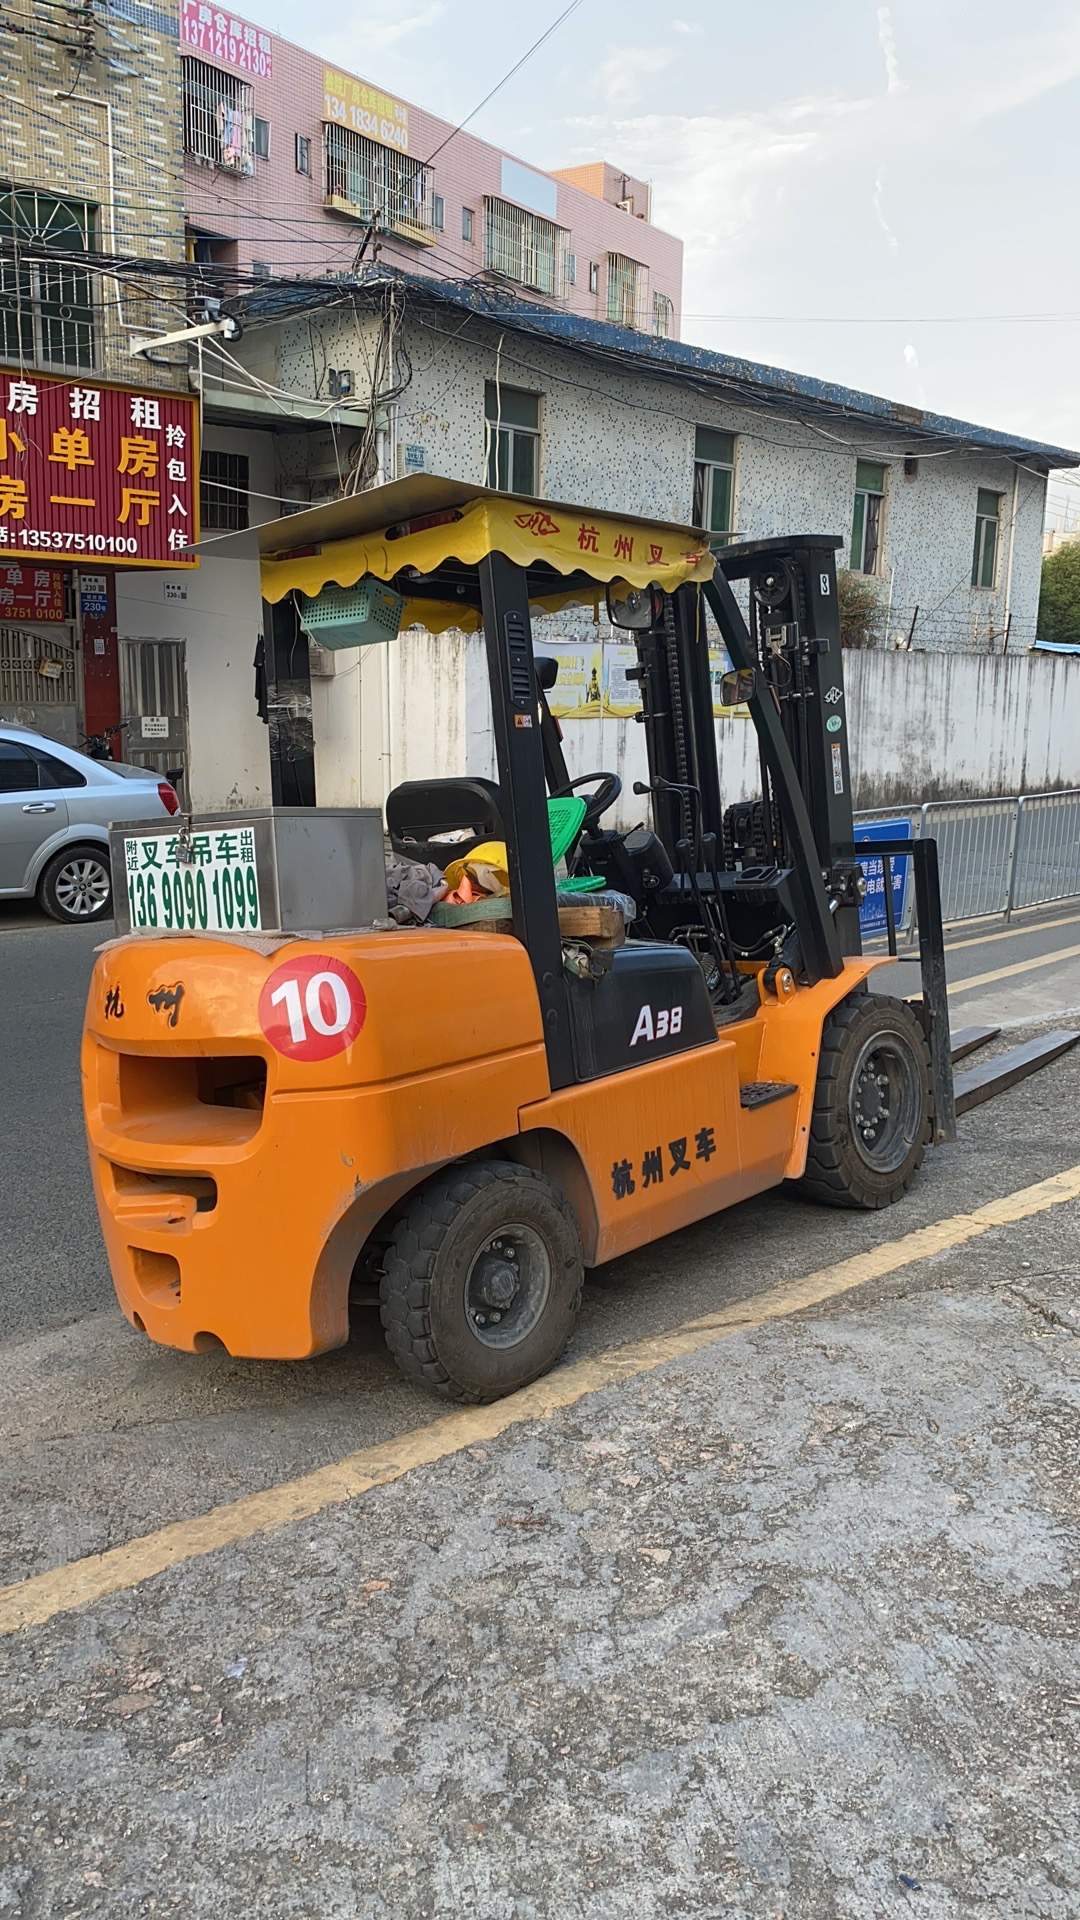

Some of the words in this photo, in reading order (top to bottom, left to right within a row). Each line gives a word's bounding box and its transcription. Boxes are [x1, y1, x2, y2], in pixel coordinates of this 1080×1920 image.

[184, 16, 205, 48] 137
[209, 28, 237, 62] 1219
[239, 42, 266, 76] 2130
[8, 381, 162, 430] 房招租
[0, 475, 160, 526] 房一厅
[166, 424, 189, 551] 拎包入住
[36, 609, 63, 619] 0100
[126, 840, 139, 871] 附近
[141, 833, 239, 870] 叉车吊车
[240, 830, 254, 863] 出租
[129, 872, 158, 927] 136
[162, 869, 208, 929] 9090
[213, 866, 258, 929] 1099
[271, 971, 351, 1044] 10
[629, 1004, 683, 1047] A38
[611, 1127, 717, 1200] 杭州叉车
